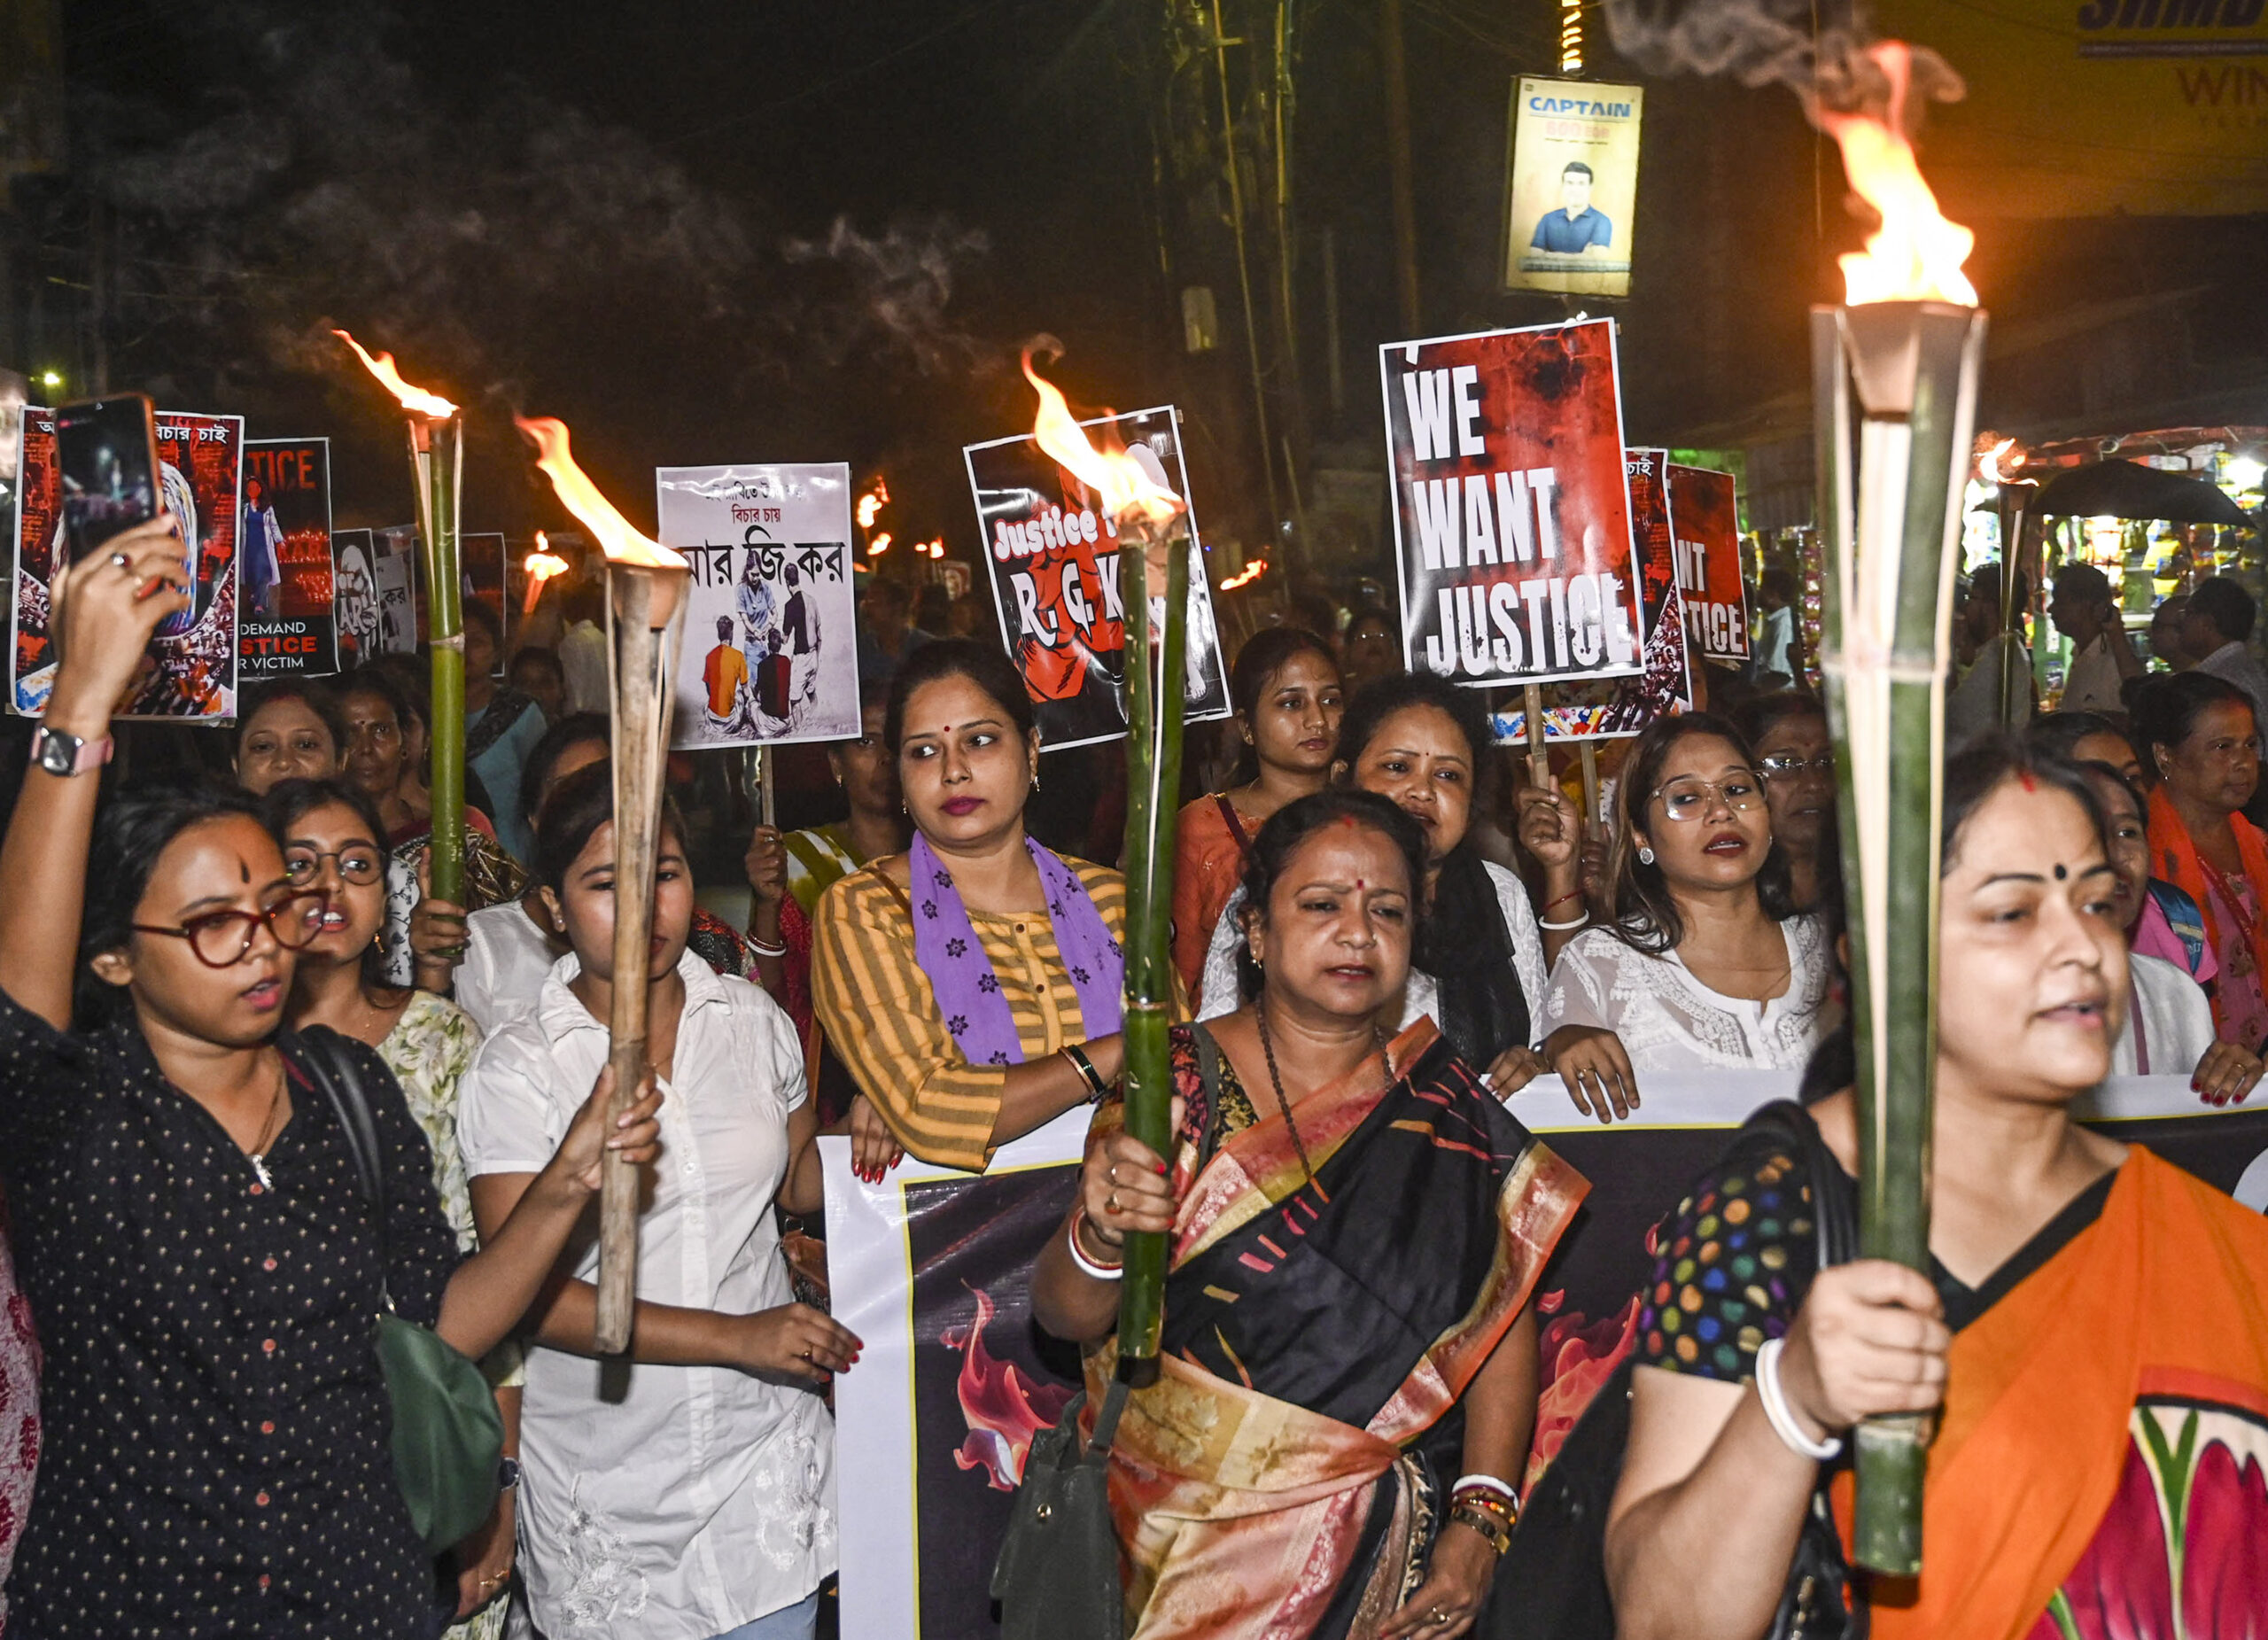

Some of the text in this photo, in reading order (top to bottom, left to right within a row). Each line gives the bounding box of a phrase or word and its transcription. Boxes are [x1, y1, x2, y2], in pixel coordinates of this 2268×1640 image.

[1529, 97, 1631, 117] CAPTAIN
[1403, 365, 1486, 461] WE
[196, 424, 230, 444] চাই
[245, 450, 316, 488] TICE
[731, 503, 760, 525] বিচার
[994, 504, 1099, 562] Justice
[1412, 467, 1556, 570] WANT
[793, 541, 846, 585] কর
[1677, 539, 1705, 593] NT
[240, 622, 307, 635] DEMAND
[1425, 572, 1633, 677] JUSTICE
[1682, 599, 1744, 654] TICE
[240, 636, 317, 656] STICE
[252, 657, 304, 669] VICTIM
